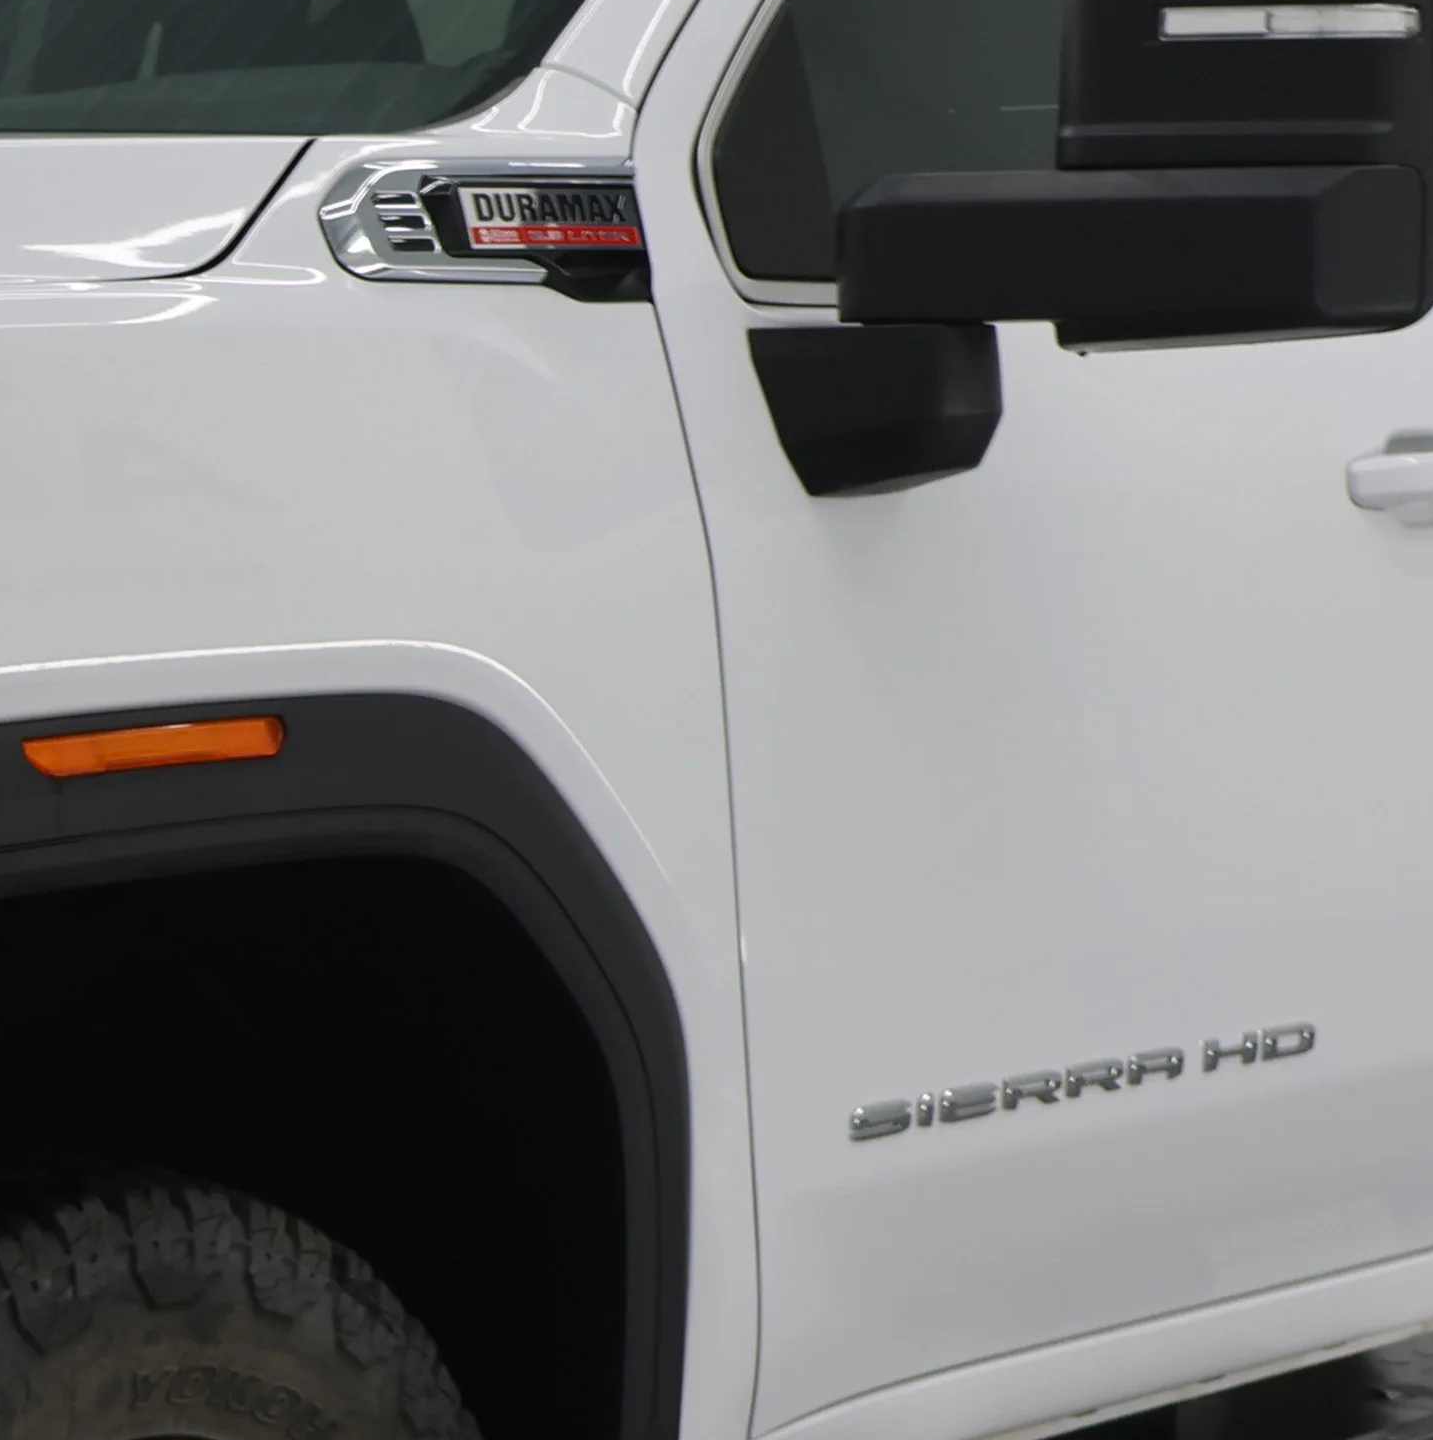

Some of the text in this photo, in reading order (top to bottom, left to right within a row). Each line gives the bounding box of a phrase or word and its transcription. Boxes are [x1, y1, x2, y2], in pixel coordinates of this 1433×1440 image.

[472, 193, 627, 222] DURAMAX
[849, 1021, 1317, 1142] SIERRA HD
